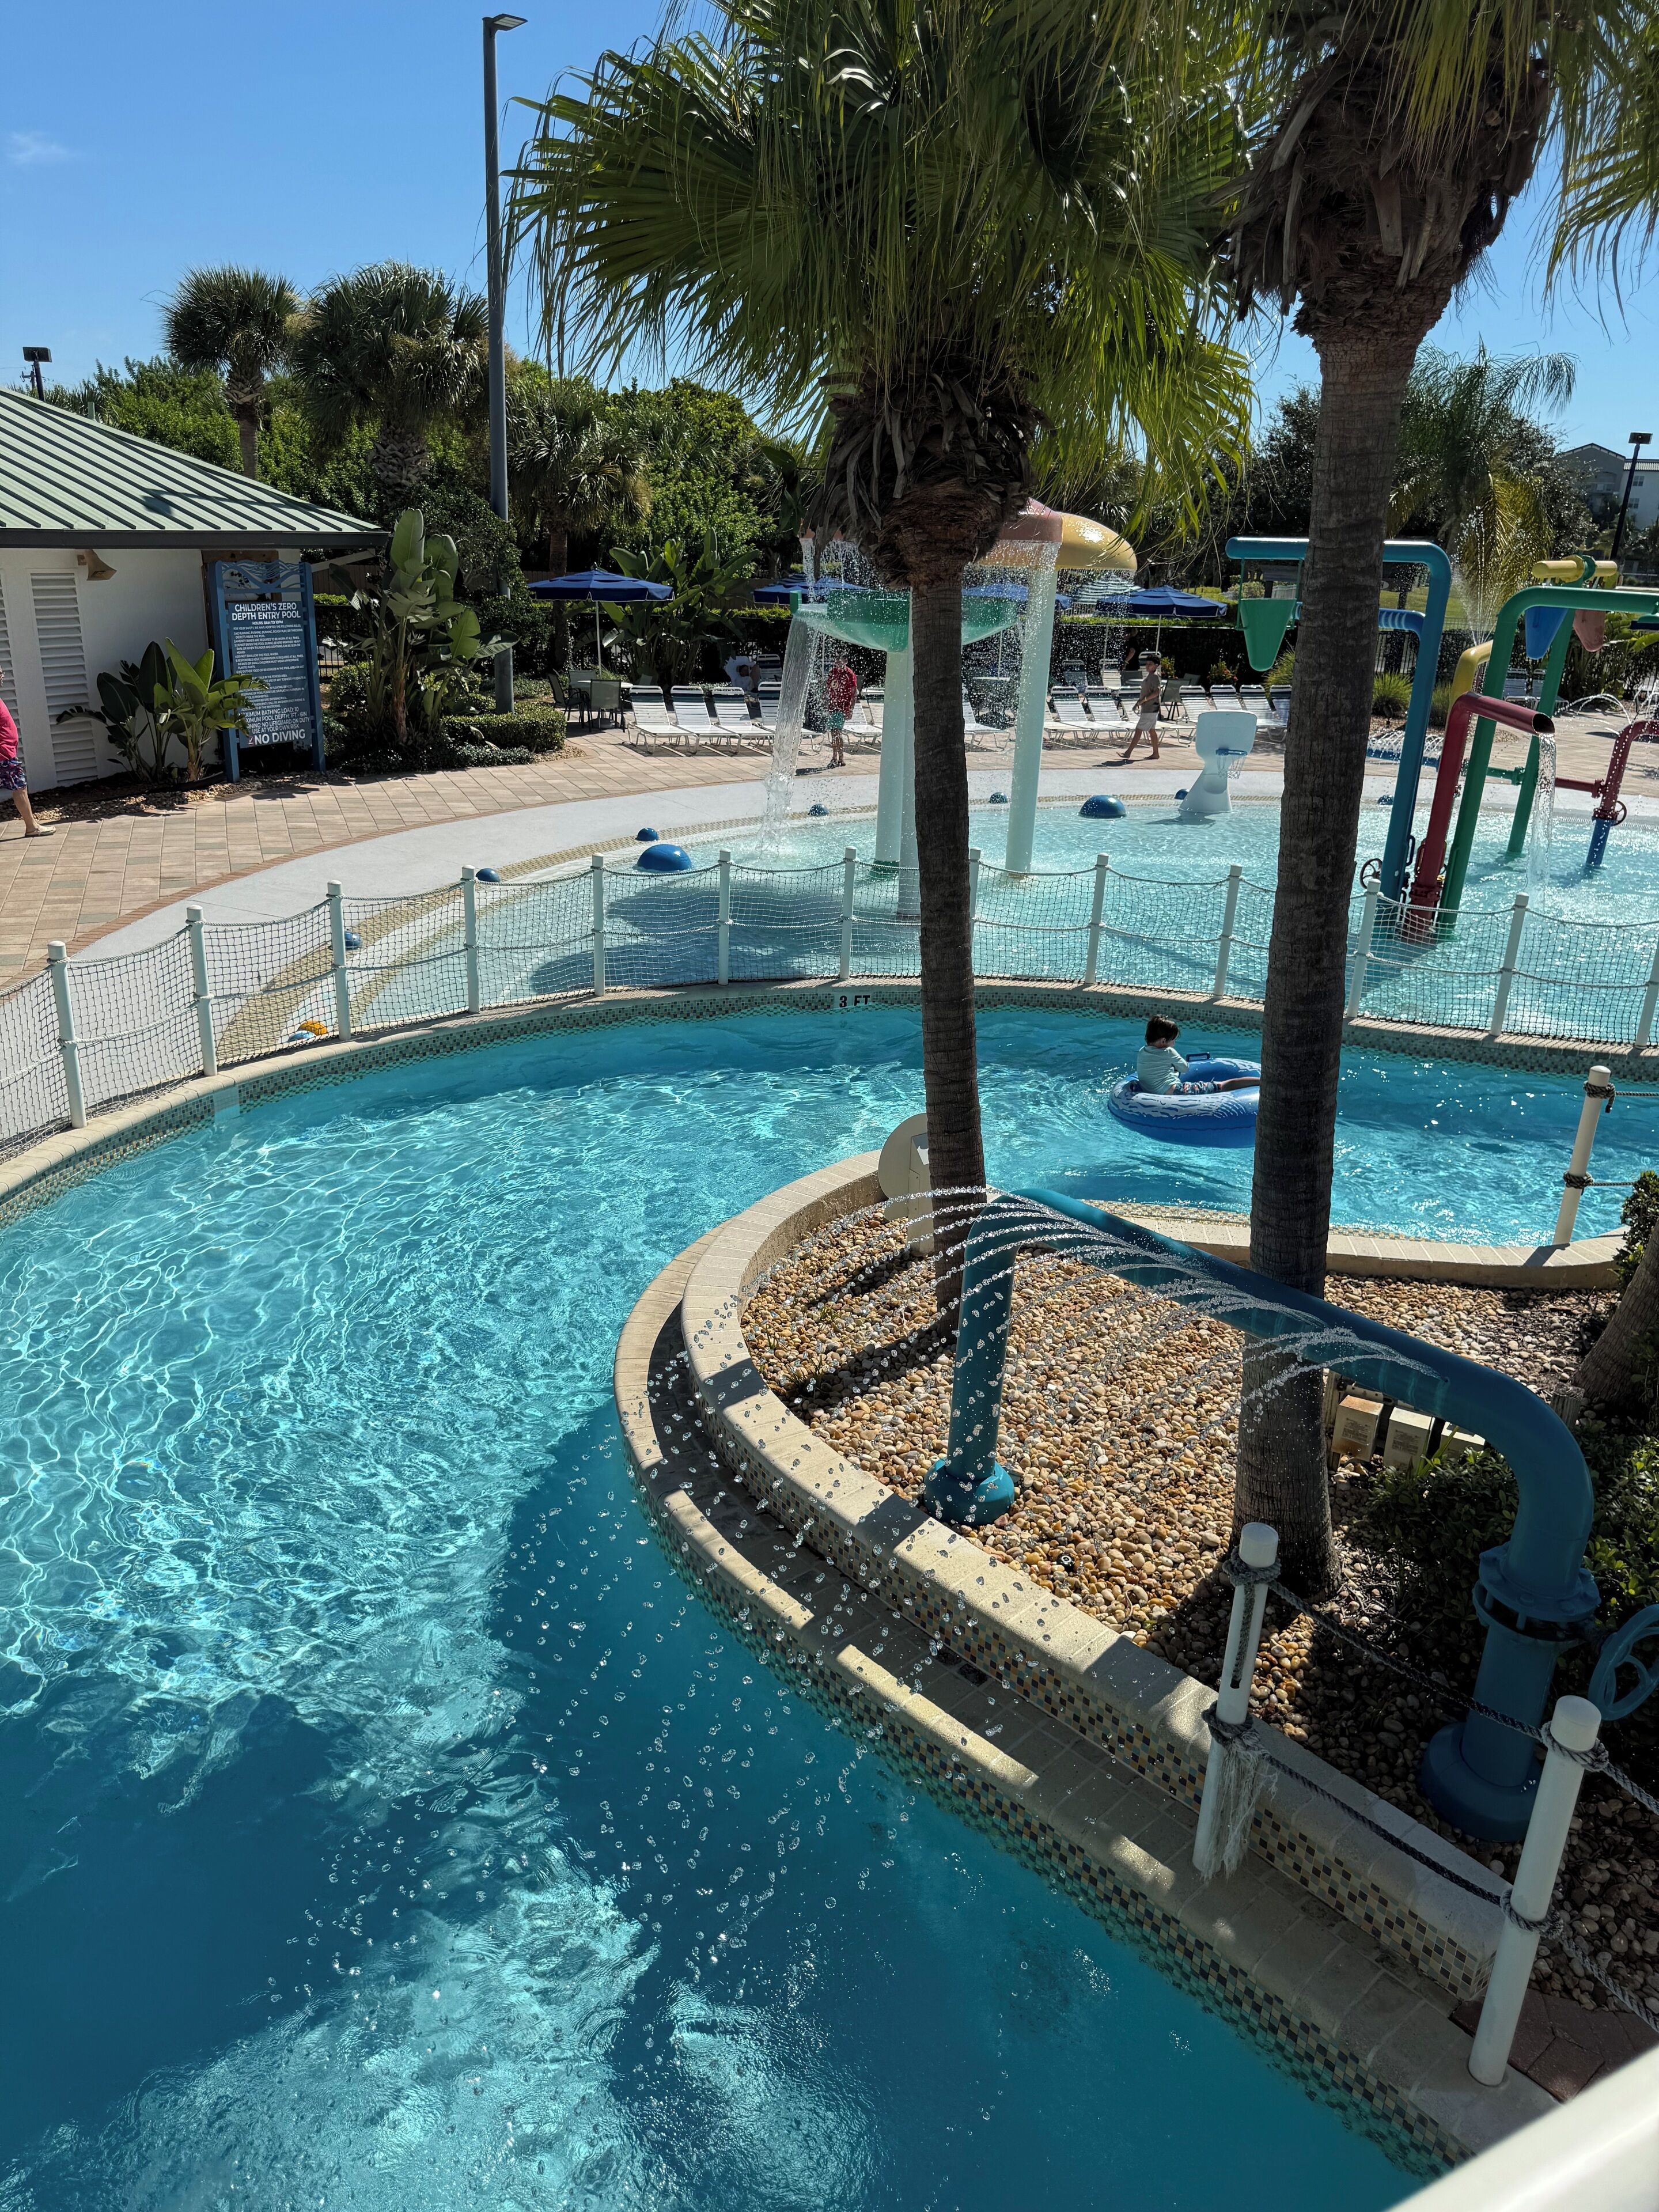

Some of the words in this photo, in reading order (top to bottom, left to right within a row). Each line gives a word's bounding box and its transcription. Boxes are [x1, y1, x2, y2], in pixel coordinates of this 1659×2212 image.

[234, 603, 277, 612] CHILDREN'S
[278, 602, 297, 611] ZERO
[232, 612, 256, 621] DEPTH
[257, 611, 280, 620] ENTRY
[282, 611, 301, 619] POOL
[262, 708, 281, 716] BATHING
[269, 719, 292, 727] LIFEGUARD
[254, 733, 270, 745] NO
[272, 729, 305, 743] DIVING
[839, 995, 847, 1007] 3
[854, 995, 870, 1006] FT
